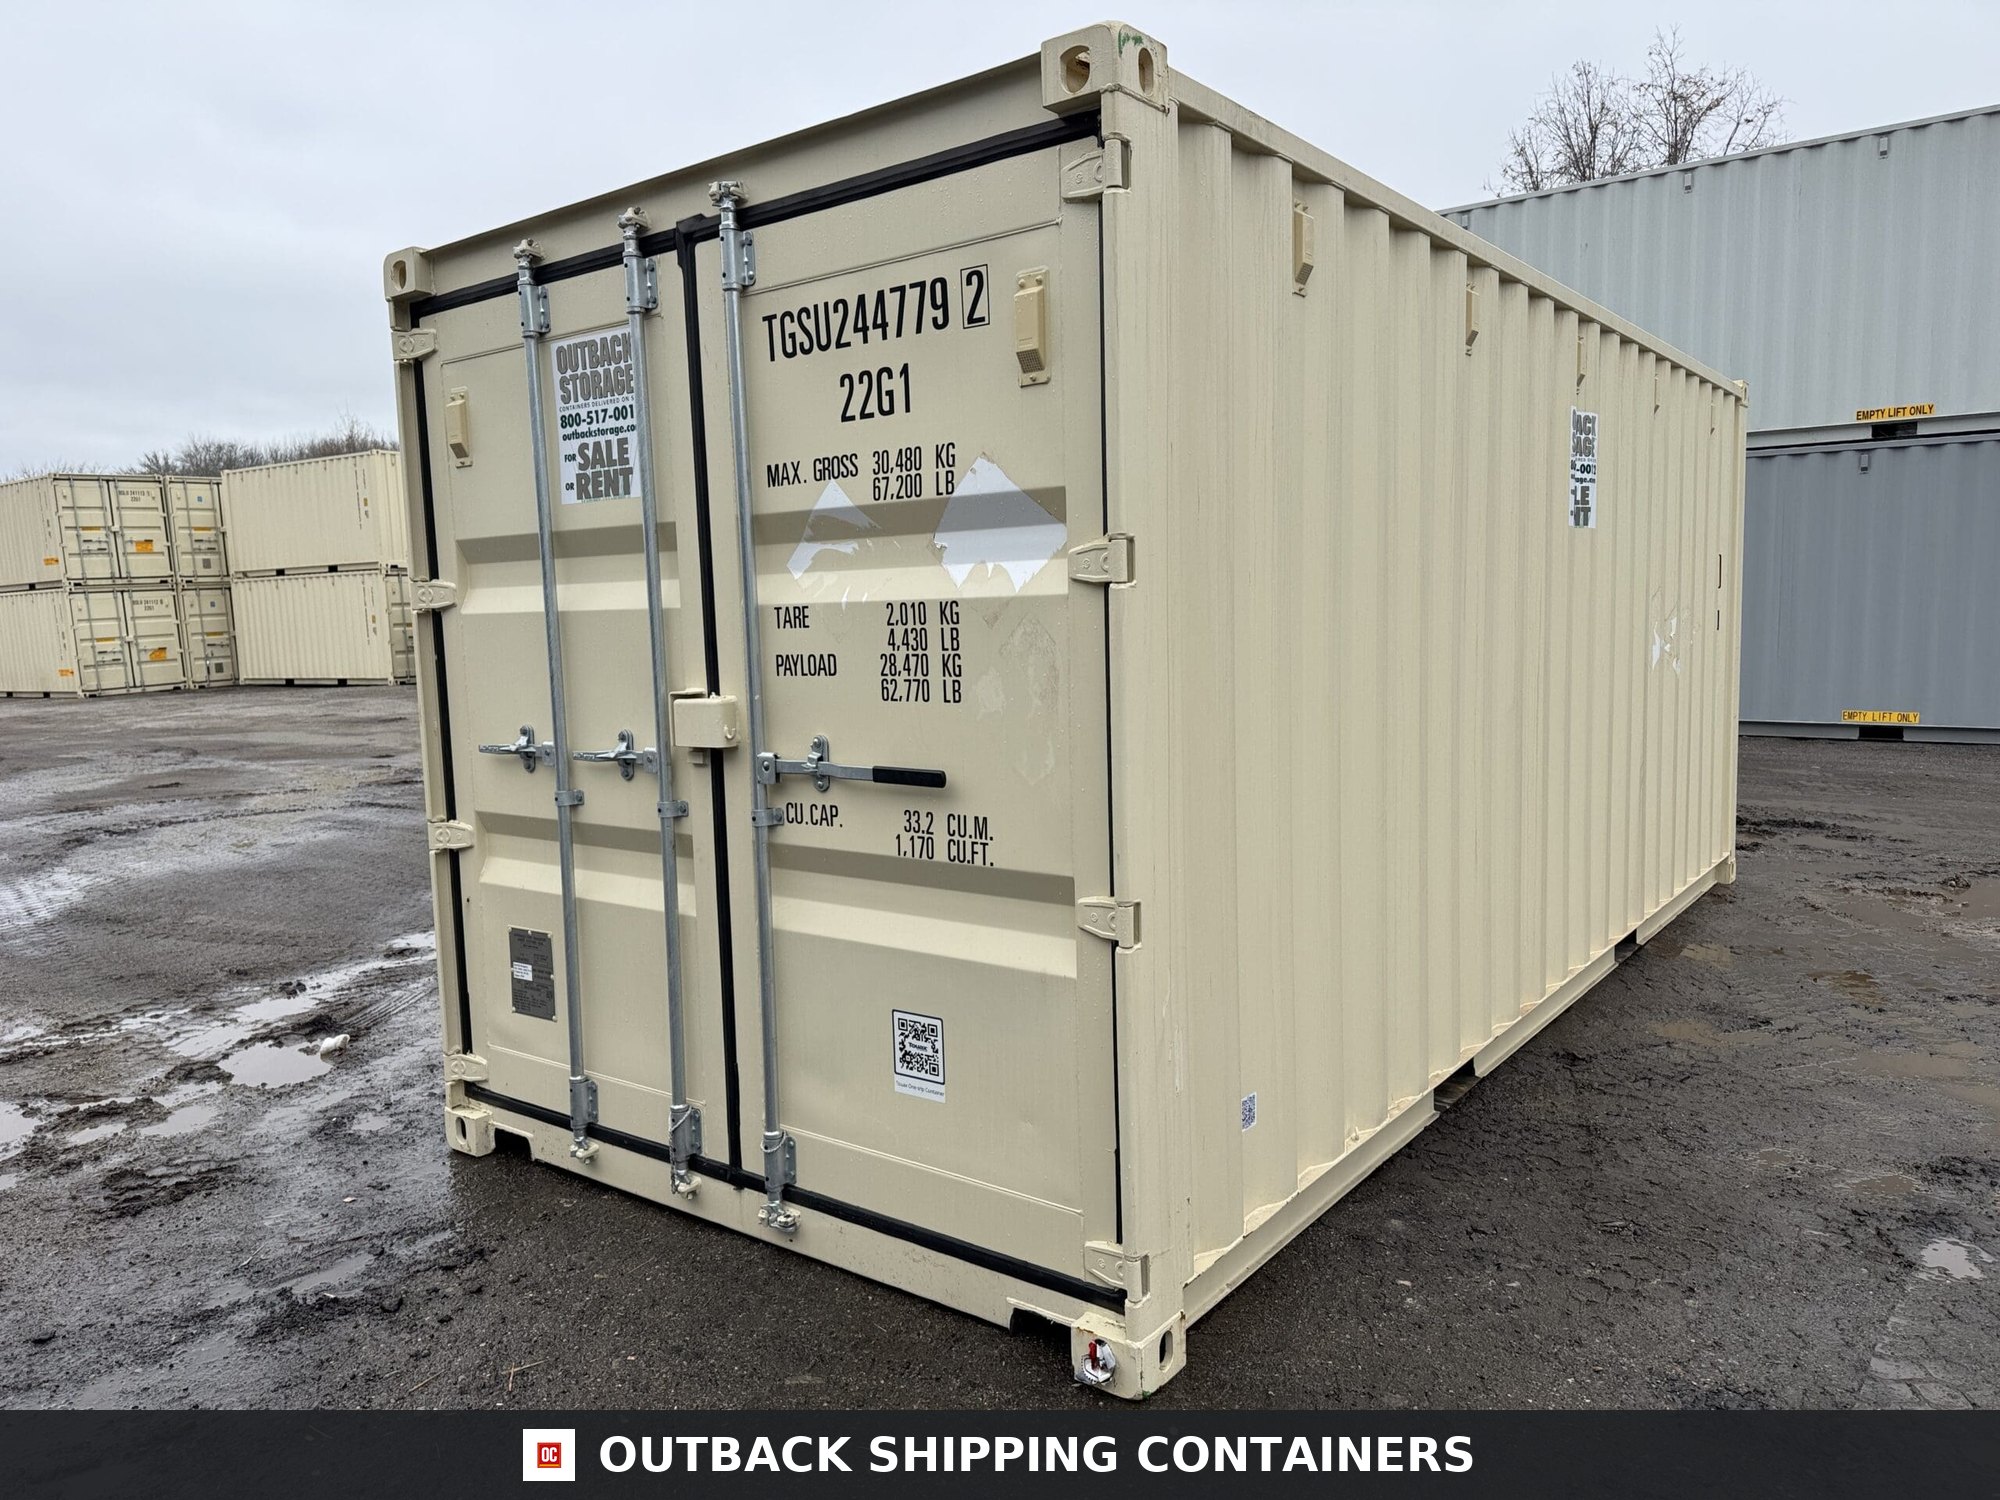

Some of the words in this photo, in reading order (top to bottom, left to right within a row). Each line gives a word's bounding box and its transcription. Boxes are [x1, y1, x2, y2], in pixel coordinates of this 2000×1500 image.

[762, 277, 950, 362] TGSU244779
[965, 270, 986, 325] 2
[556, 331, 633, 375] OUTBACK
[559, 363, 635, 405] STORAGE
[840, 362, 911, 423] 22G1
[558, 401, 591, 413] CONTAINERS
[591, 397, 620, 408] DELIVERED
[560, 404, 635, 430] 800-517-001
[1856, 408, 1886, 421] EMPTY
[1888, 406, 1907, 418] LIFT
[1909, 404, 1934, 416] ONLY
[562, 423, 636, 441] outbackstorage.co
[564, 453, 577, 463] FOR
[578, 437, 630, 471] SALE
[766, 460, 807, 488] MAX.
[813, 453, 859, 483] GROSS
[872, 446, 923, 476] 30,480
[935, 442, 956, 468] KG
[565, 482, 575, 491] OR
[576, 466, 634, 500] RENT
[872, 473, 923, 501] 67,200
[935, 470, 955, 496] LB
[774, 605, 810, 629] TARE
[886, 602, 927, 627] 2,010
[939, 601, 960, 626] KG
[887, 628, 928, 652] 4,430
[940, 627, 960, 652] LB
[775, 654, 838, 677] PAYLOAD
[880, 653, 929, 678] 28,470
[942, 653, 962, 678] KG
[880, 679, 931, 703] 62,770
[943, 680, 962, 703] LB
[1843, 711, 1868, 721] EMPTY
[1872, 712, 1893, 722] LIFT
[1896, 712, 1919, 723] ONLY
[903, 809, 934, 835] 33.2
[895, 833, 935, 860] 1,170
